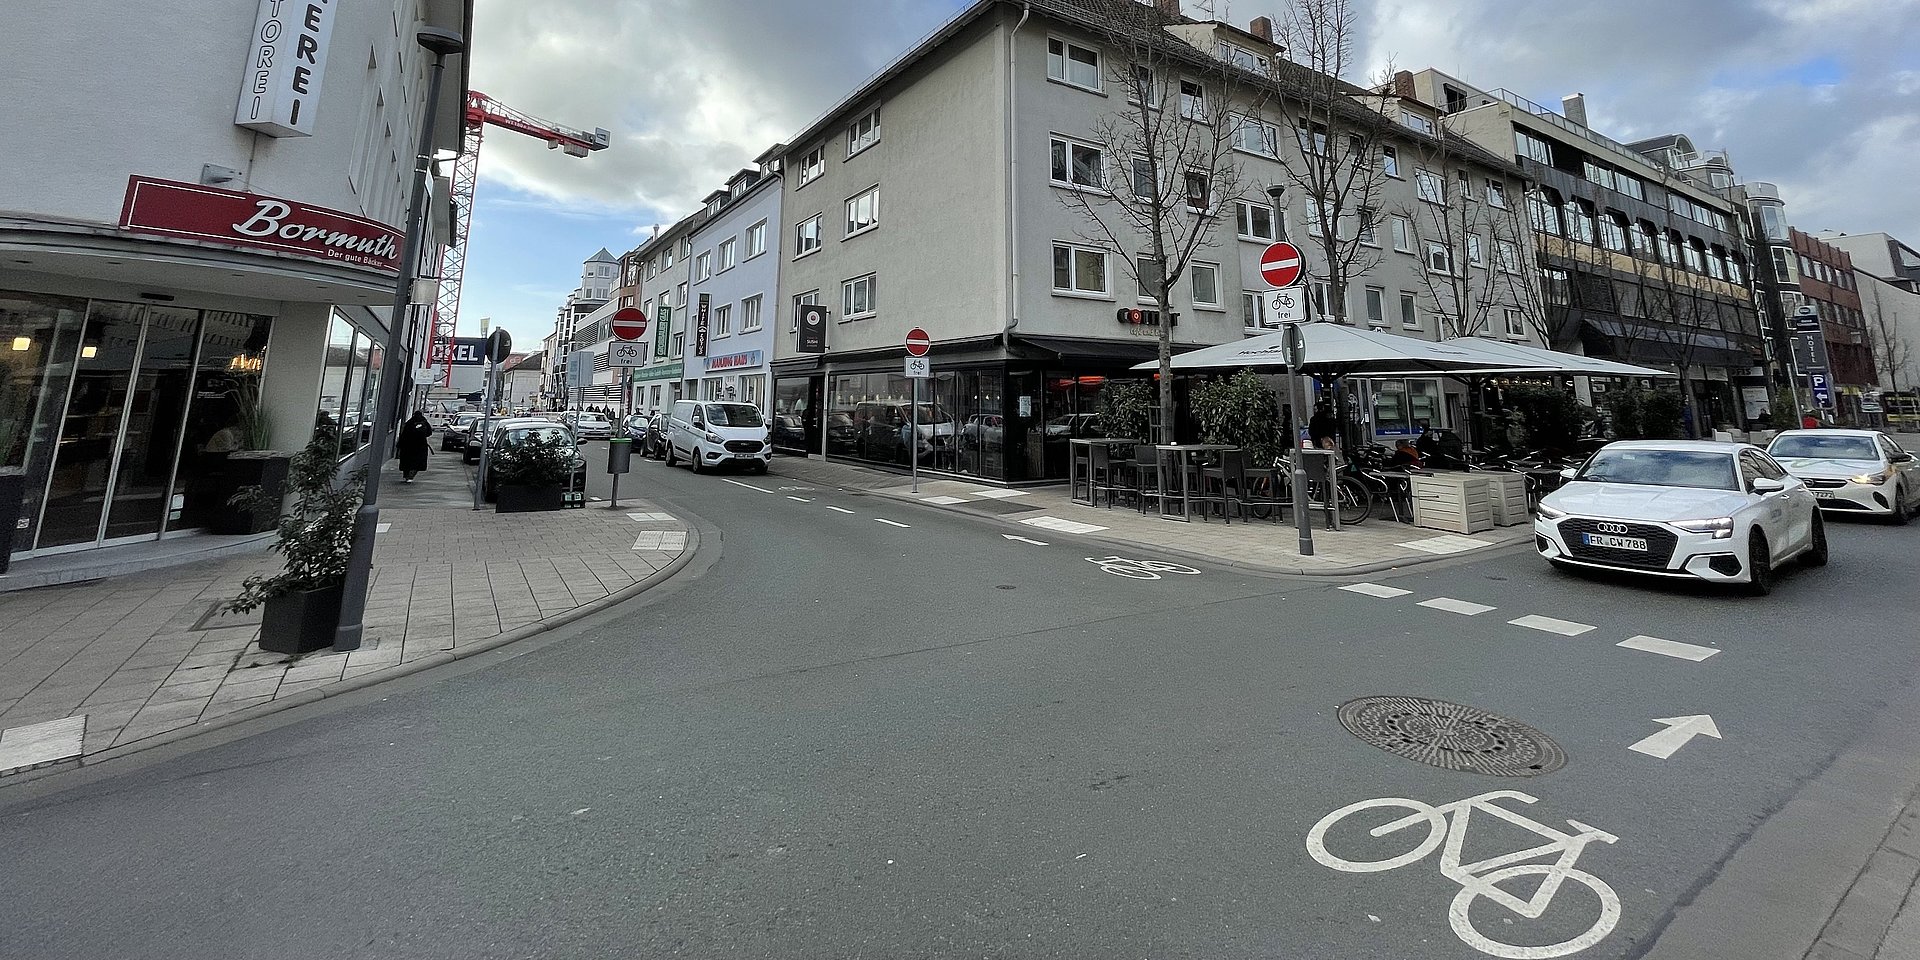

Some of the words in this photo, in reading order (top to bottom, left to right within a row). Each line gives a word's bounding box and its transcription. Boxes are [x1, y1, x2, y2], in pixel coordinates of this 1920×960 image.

[290, 0, 328, 125] EREI
[232, 200, 398, 260] Bormuth
[328, 249, 344, 259] Der
[345, 253, 362, 265] gute
[363, 256, 383, 267] Bäcker
[1277, 311, 1291, 319] frei
[1806, 335, 1816, 363] HOTEL
[1813, 376, 1824, 387] P
[1590, 535, 1604, 545] FR
[1609, 537, 1624, 548] CW
[1624, 539, 1647, 550] 788
